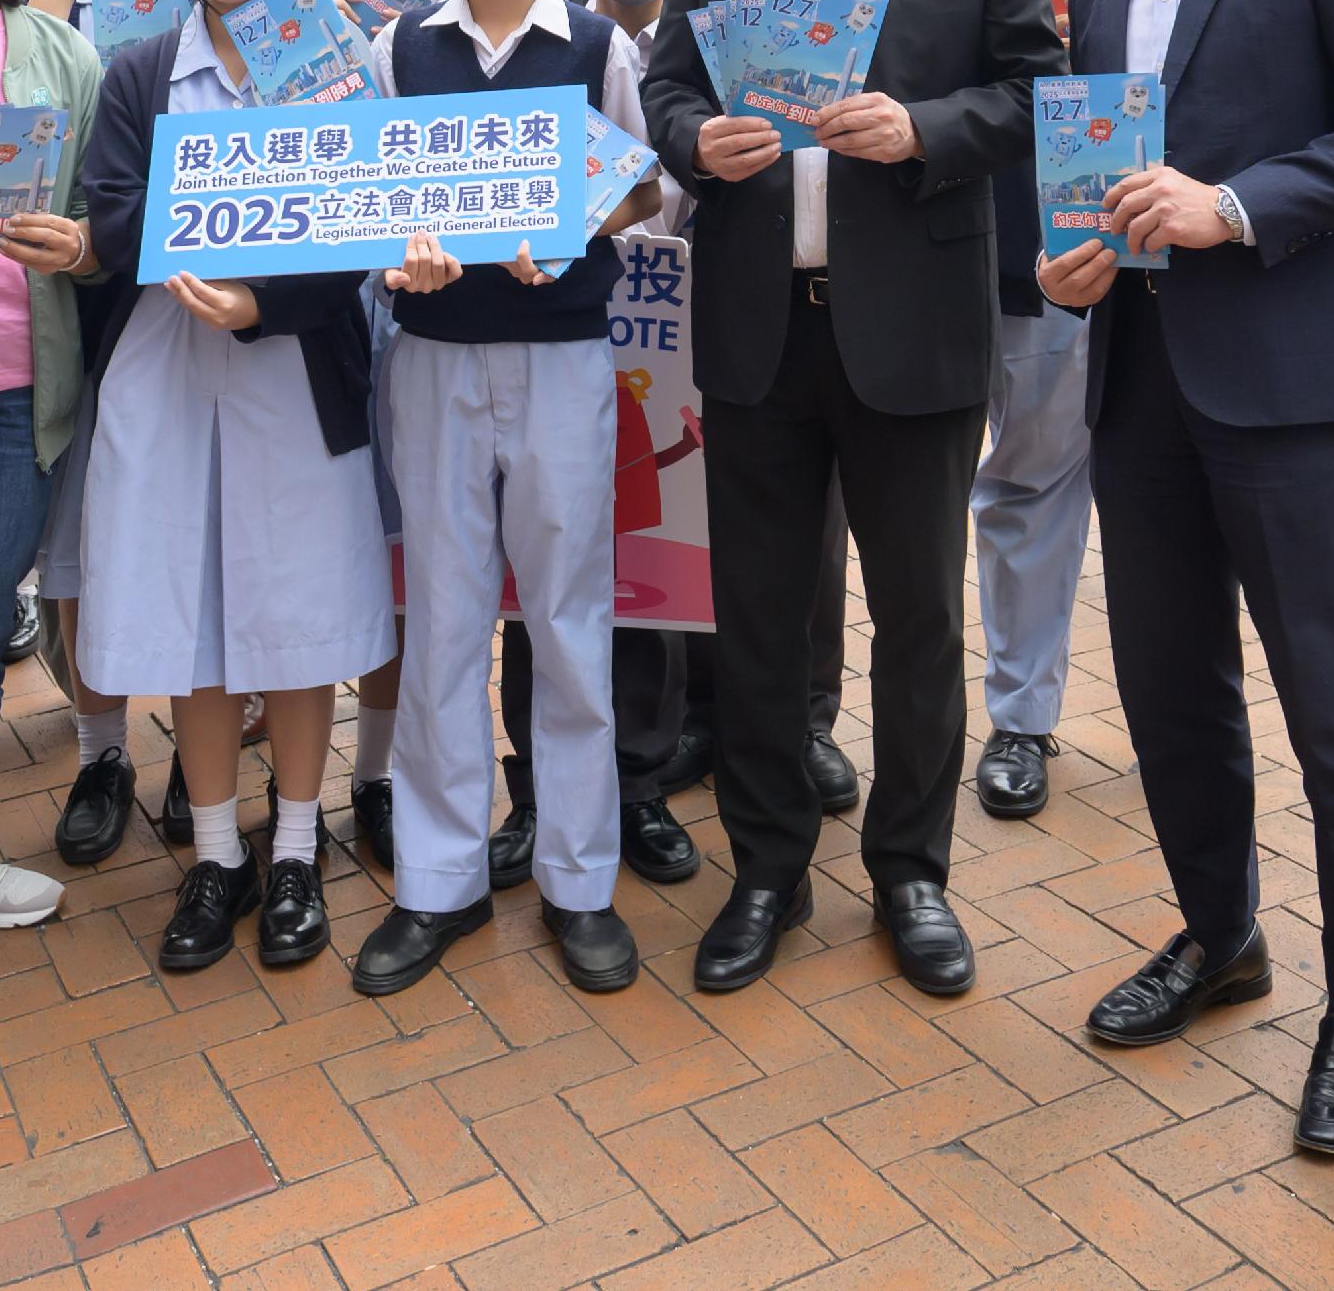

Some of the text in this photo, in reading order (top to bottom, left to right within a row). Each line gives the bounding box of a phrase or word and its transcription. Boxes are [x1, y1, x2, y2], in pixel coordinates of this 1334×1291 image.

[310, 71, 365, 103] 到時見
[179, 128, 348, 171] 投入選舉
[382, 114, 555, 157] 共創未來
[174, 155, 557, 191] Join the Election Together We Create the Future
[169, 180, 555, 248] 2025 立法會換屆選舉
[316, 223, 388, 240] Legislative
[444, 217, 497, 232] General
[500, 215, 555, 228] Election
[608, 315, 679, 352] OTE
